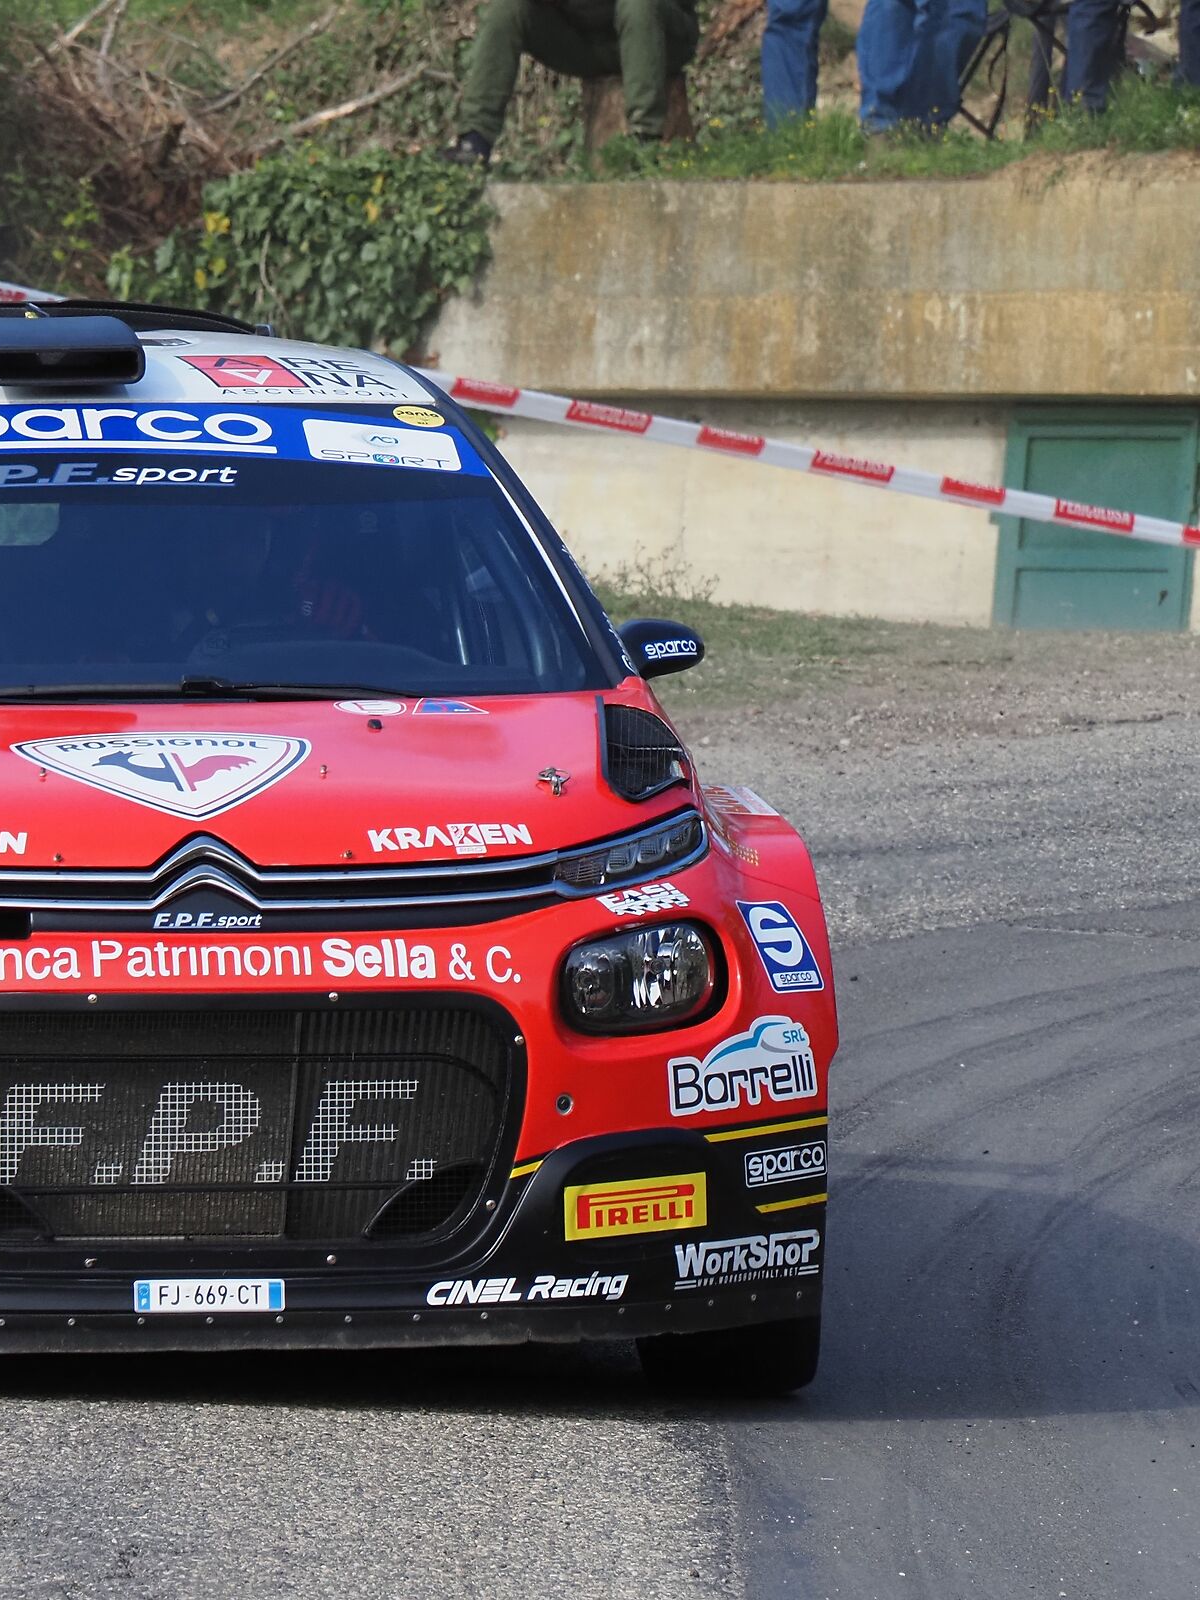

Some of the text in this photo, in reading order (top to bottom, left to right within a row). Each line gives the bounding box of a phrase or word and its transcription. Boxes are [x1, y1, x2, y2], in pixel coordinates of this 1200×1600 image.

[221, 388, 410, 399] ASCENSORI
[644, 638, 698, 660] sparco
[55, 737, 270, 753] ROSSIGNOL
[367, 823, 533, 852] KRAKEN
[92, 939, 313, 978] Patrimoni
[322, 938, 437, 979] Sella
[448, 946, 476, 981] &
[485, 946, 522, 984] C.
[779, 971, 814, 985] sparco
[747, 1145, 825, 1182] sparco
[576, 1183, 696, 1230] PIRELLI
[426, 1271, 630, 1306] CINEL Racing
